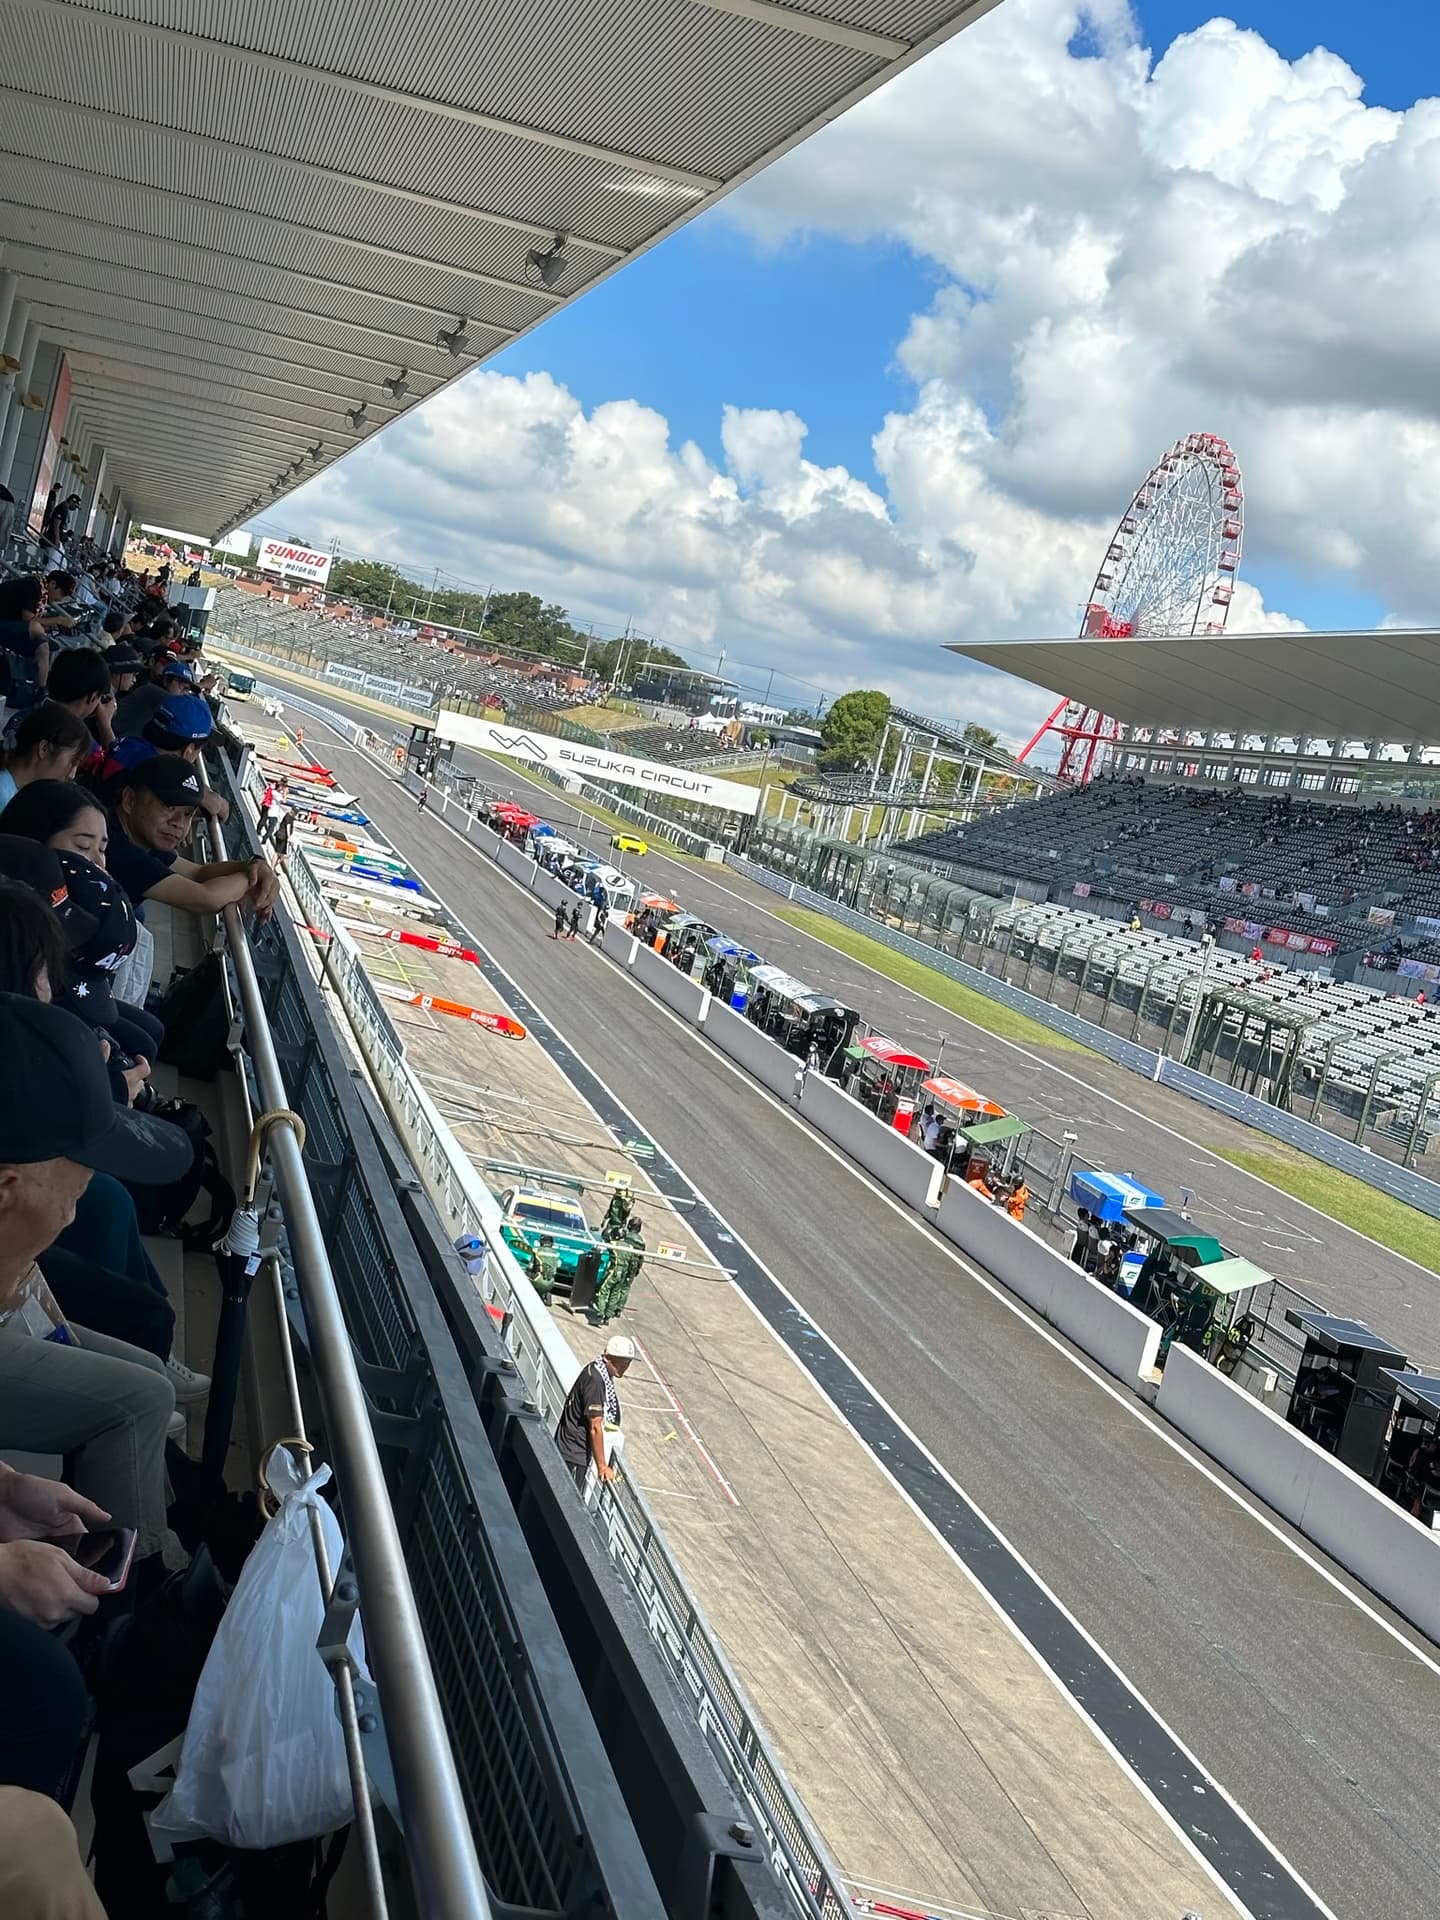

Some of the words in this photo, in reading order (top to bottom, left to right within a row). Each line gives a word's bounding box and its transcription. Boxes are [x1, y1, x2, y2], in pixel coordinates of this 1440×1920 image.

[265, 544, 328, 567] SUNOCO
[285, 563, 307, 573] MOTOR
[307, 567, 318, 577] OIL
[559, 749, 636, 776] SUZUKA
[640, 769, 713, 794] CIRCUIT
